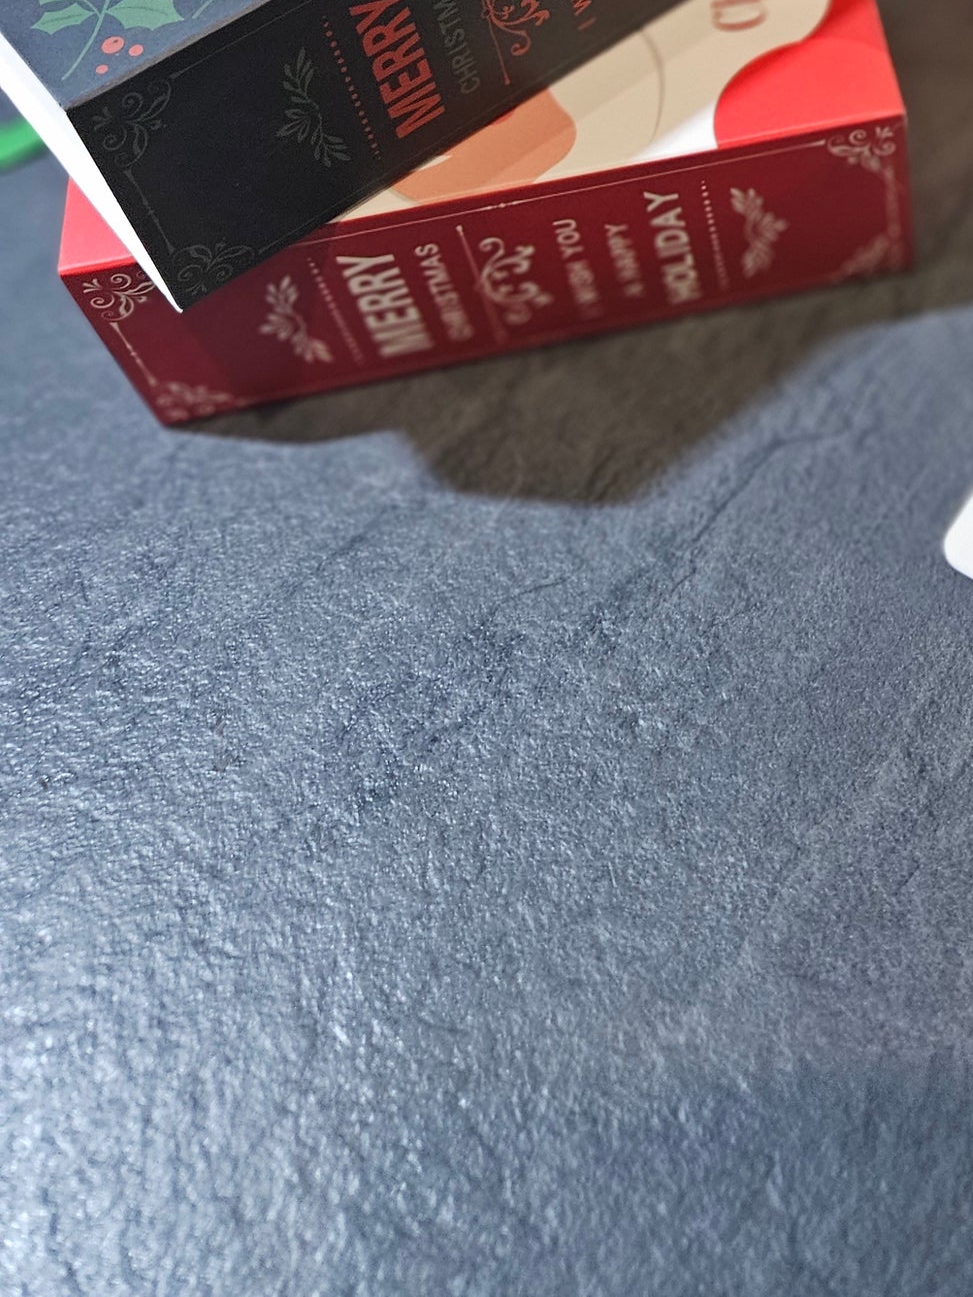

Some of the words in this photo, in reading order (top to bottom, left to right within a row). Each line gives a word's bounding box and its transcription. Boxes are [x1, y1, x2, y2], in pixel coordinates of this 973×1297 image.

[576, 16, 597, 31] I
[552, 218, 584, 258] YOU
[643, 190, 702, 305] HOLIDAY
[336, 254, 434, 358] MERRY
